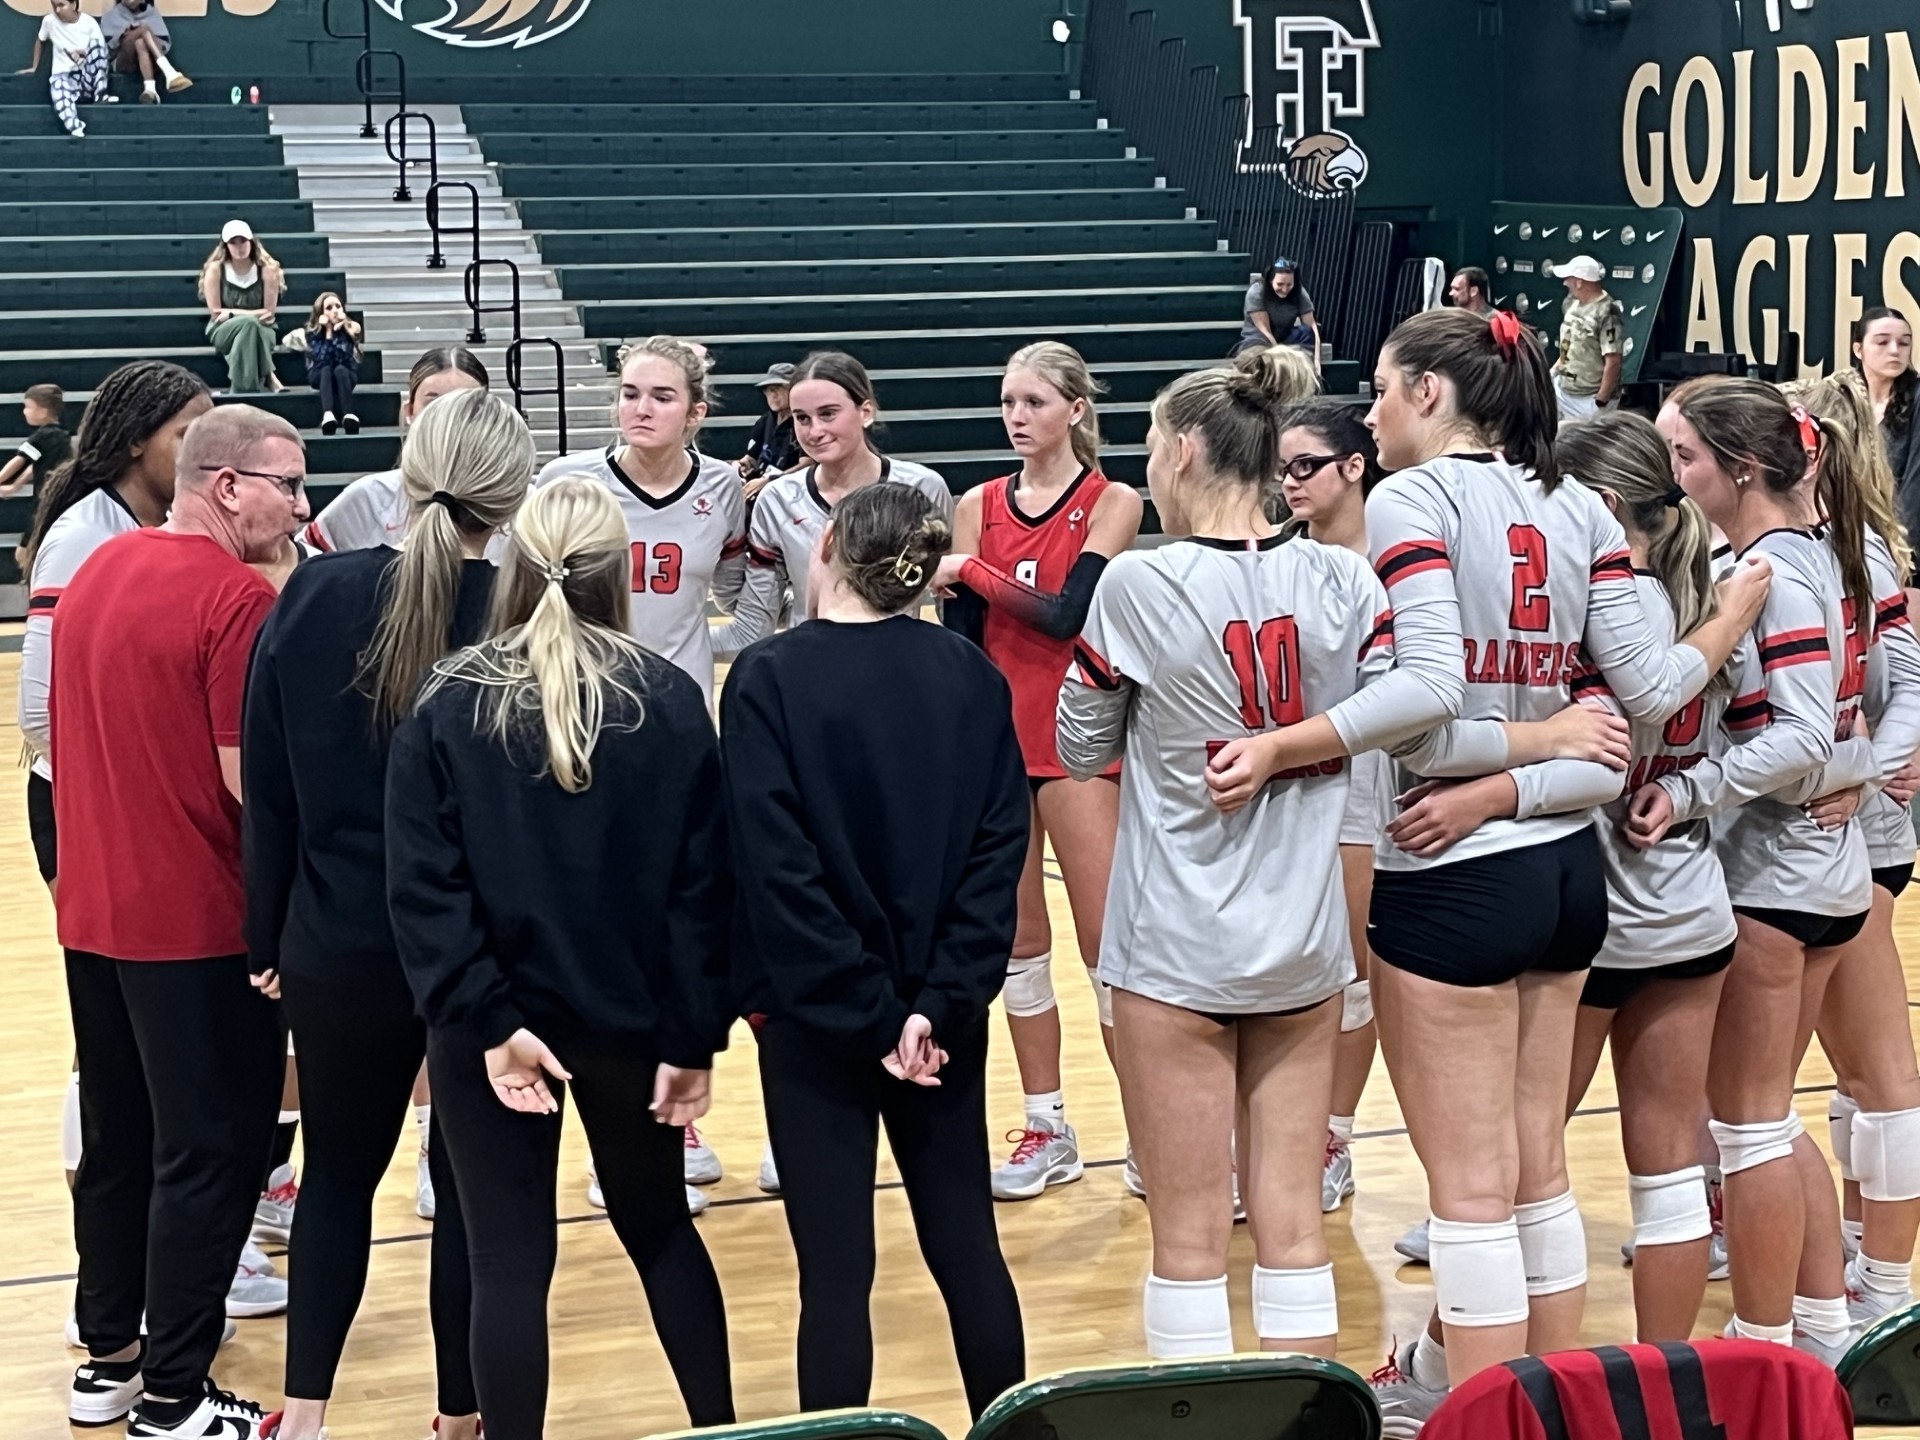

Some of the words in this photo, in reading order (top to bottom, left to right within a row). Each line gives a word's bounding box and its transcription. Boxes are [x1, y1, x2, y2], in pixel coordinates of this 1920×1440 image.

[1622, 31, 1920, 208] GOLDEN
[630, 541, 683, 594] 13
[1507, 523, 1550, 632] 2
[1222, 614, 1304, 729] 10
